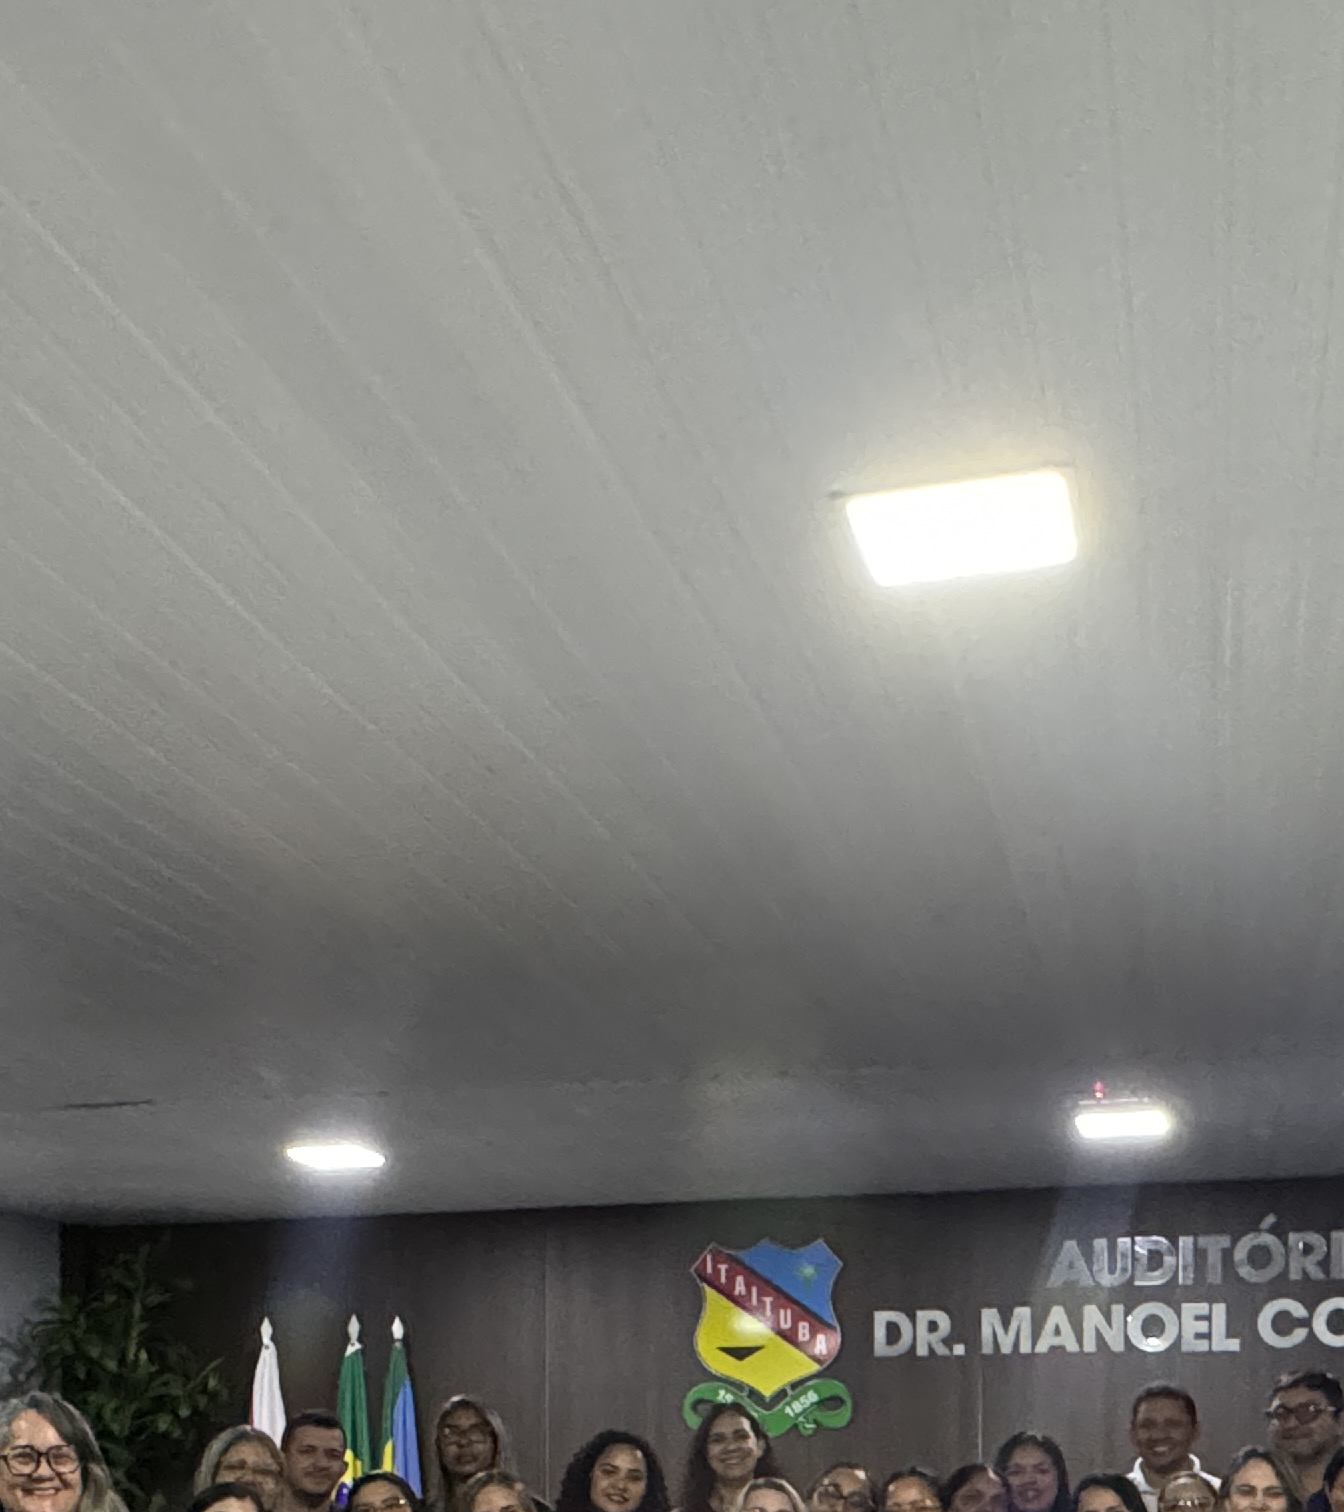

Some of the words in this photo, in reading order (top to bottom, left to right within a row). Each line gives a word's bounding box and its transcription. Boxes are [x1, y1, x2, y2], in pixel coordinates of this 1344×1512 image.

[706, 1253, 828, 1356] ITAITUBA
[873, 1309, 966, 1357] DR.
[980, 1301, 1241, 1354] MANOEL
